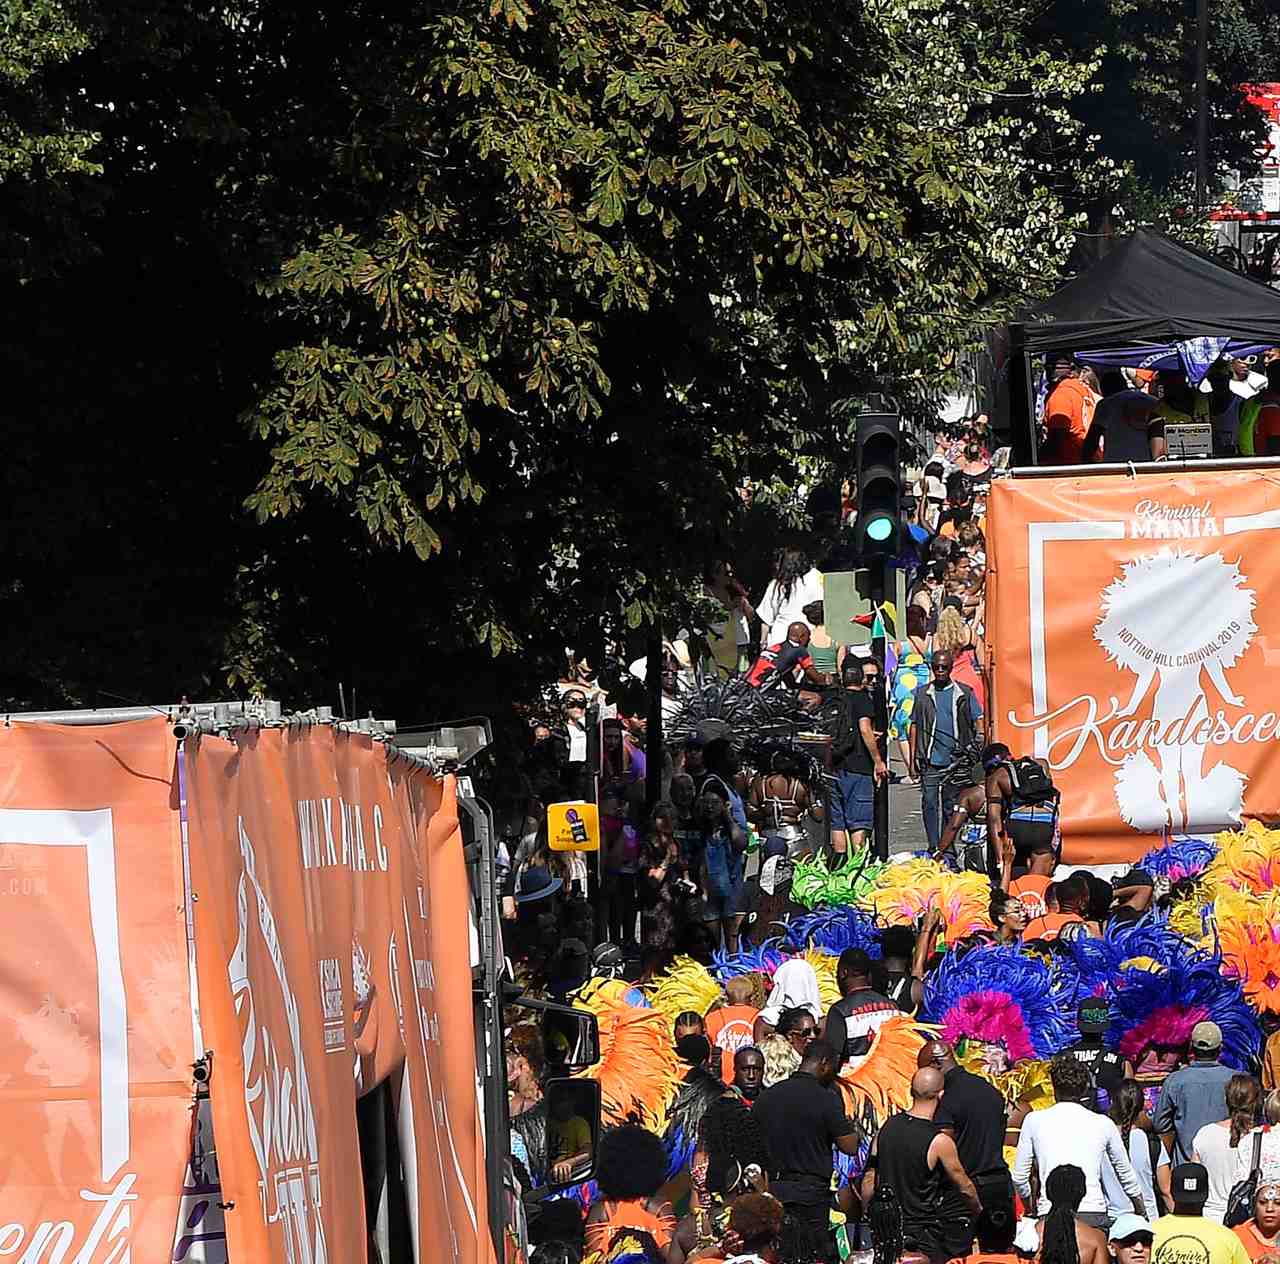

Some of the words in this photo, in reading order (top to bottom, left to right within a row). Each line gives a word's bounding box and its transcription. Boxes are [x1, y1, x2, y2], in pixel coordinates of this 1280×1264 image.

[1134, 499, 1212, 520] Karnival
[1131, 515, 1221, 539] MANIA
[1118, 627, 1154, 660] NOTTING
[1153, 652, 1174, 667] HILL
[1176, 640, 1221, 667] CARNIVAL
[1217, 620, 1241, 645] 2019
